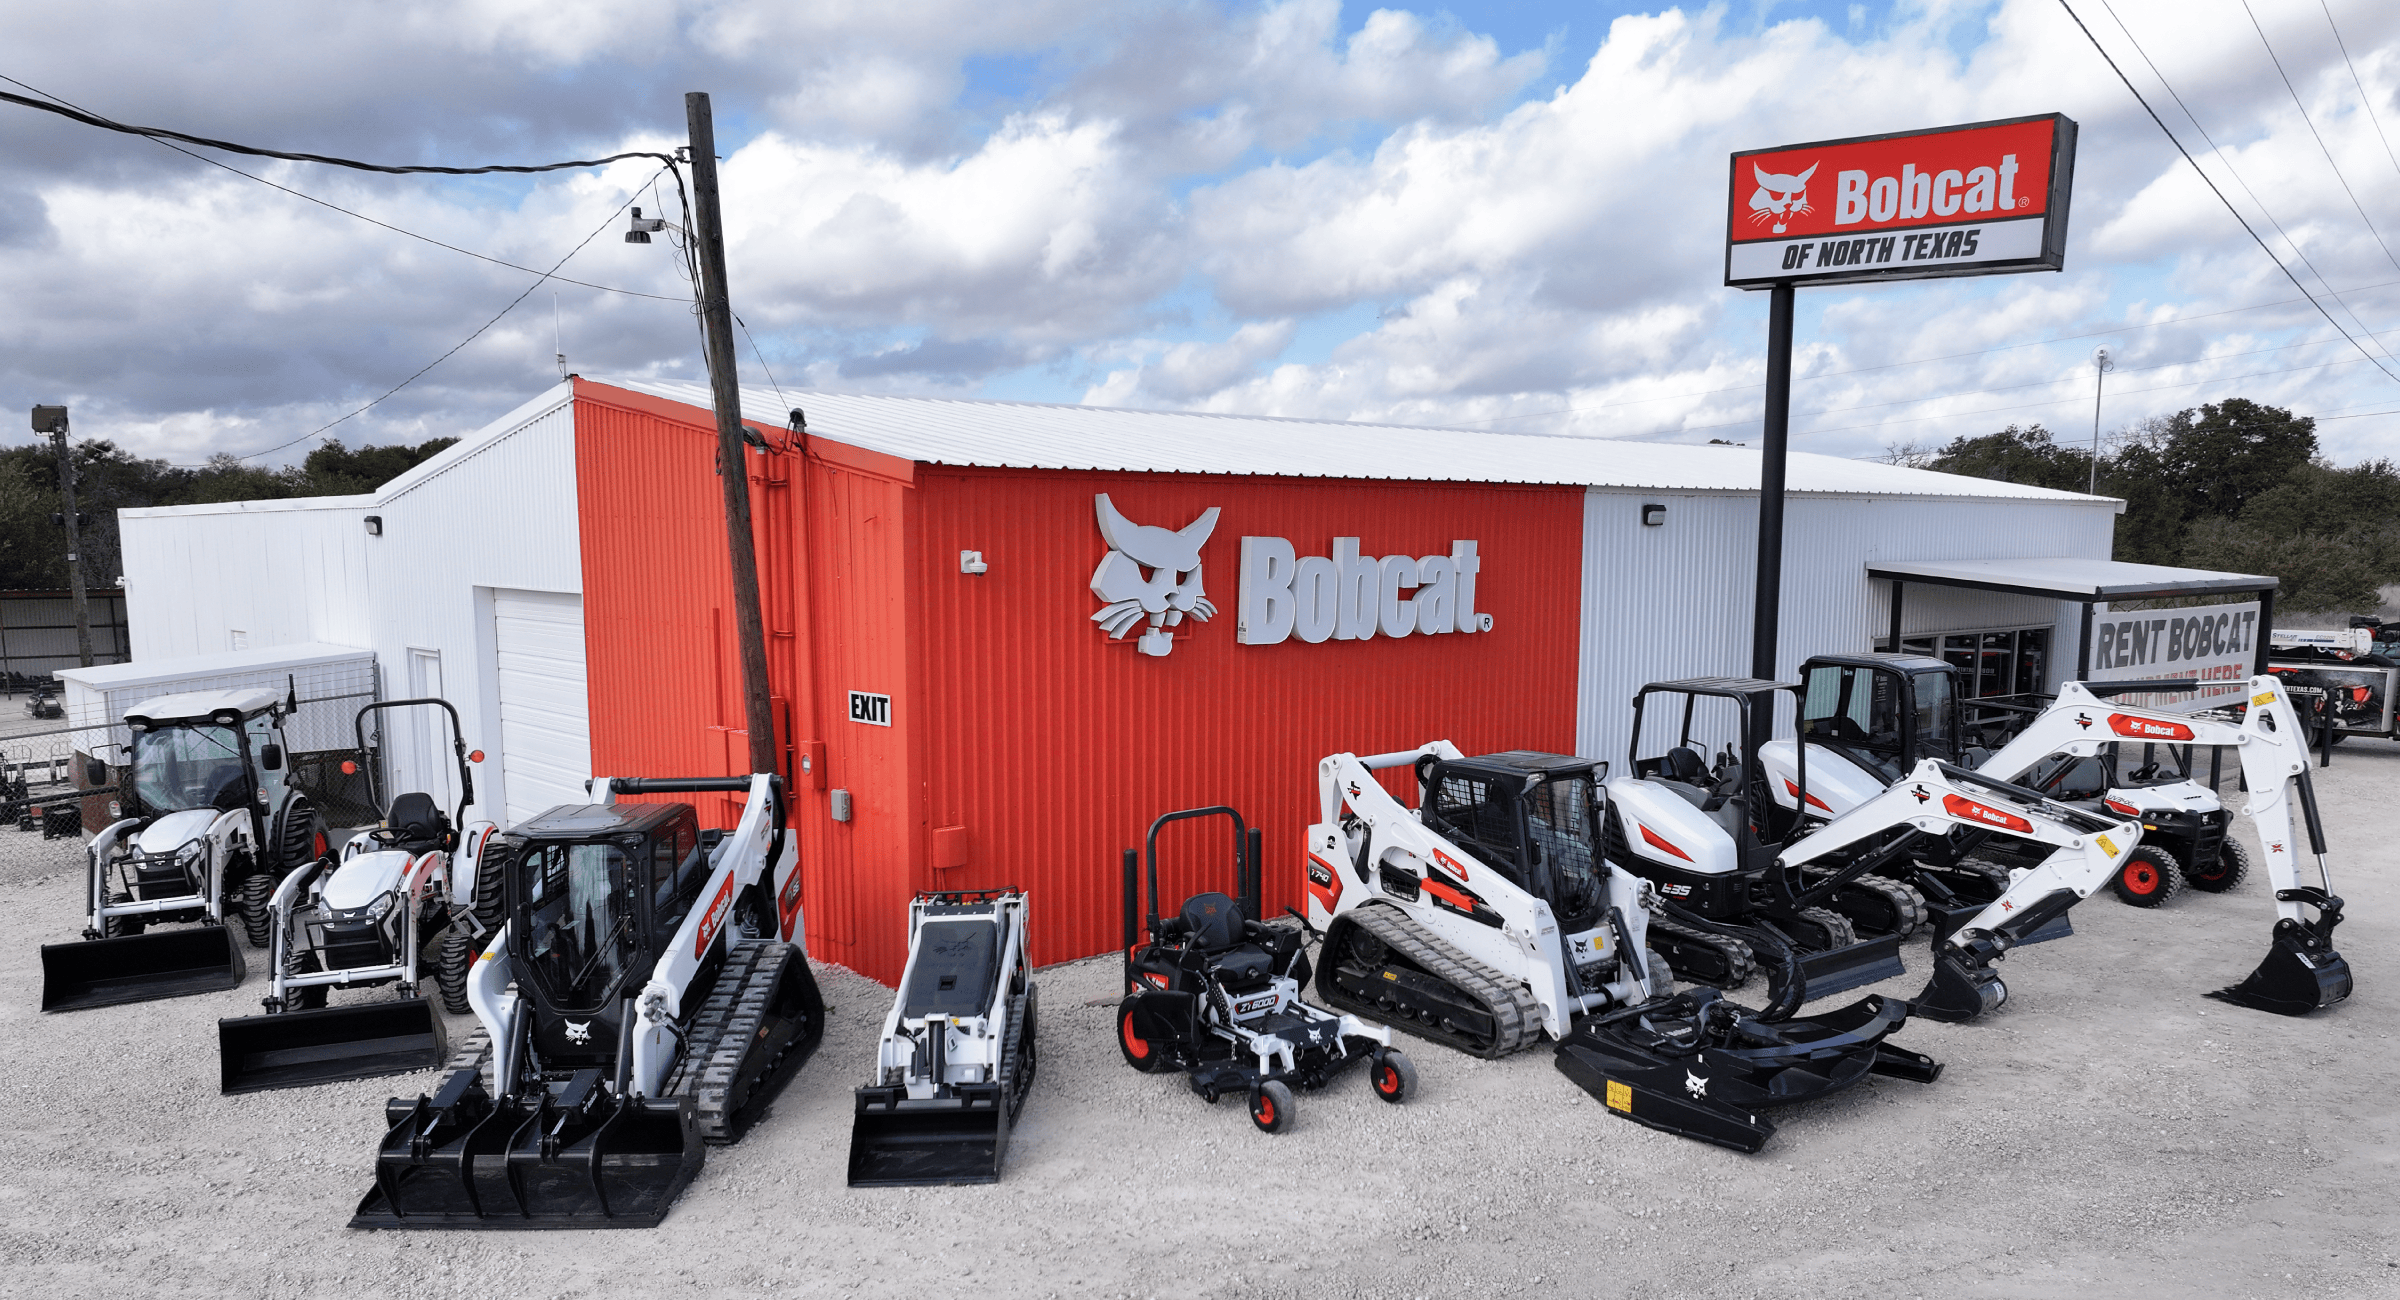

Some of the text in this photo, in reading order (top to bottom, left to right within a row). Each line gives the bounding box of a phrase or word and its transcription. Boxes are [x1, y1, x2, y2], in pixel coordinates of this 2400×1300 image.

[1835, 154, 2019, 225] Bobcat
[1781, 229, 1981, 270] OF NORTH TEXAS
[2095, 610, 2256, 670] RENT BOBCAT
[851, 693, 888, 722] EXIT
[2144, 723, 2175, 736] Bobcat
[1982, 810, 2007, 824] Bobcat
[1311, 868, 1330, 882] T740
[1446, 861, 1463, 877] Bobcat
[1661, 883, 1692, 896] E35
[711, 889, 730, 928] Bobcat
[1239, 996, 1276, 1013] ZT6000
